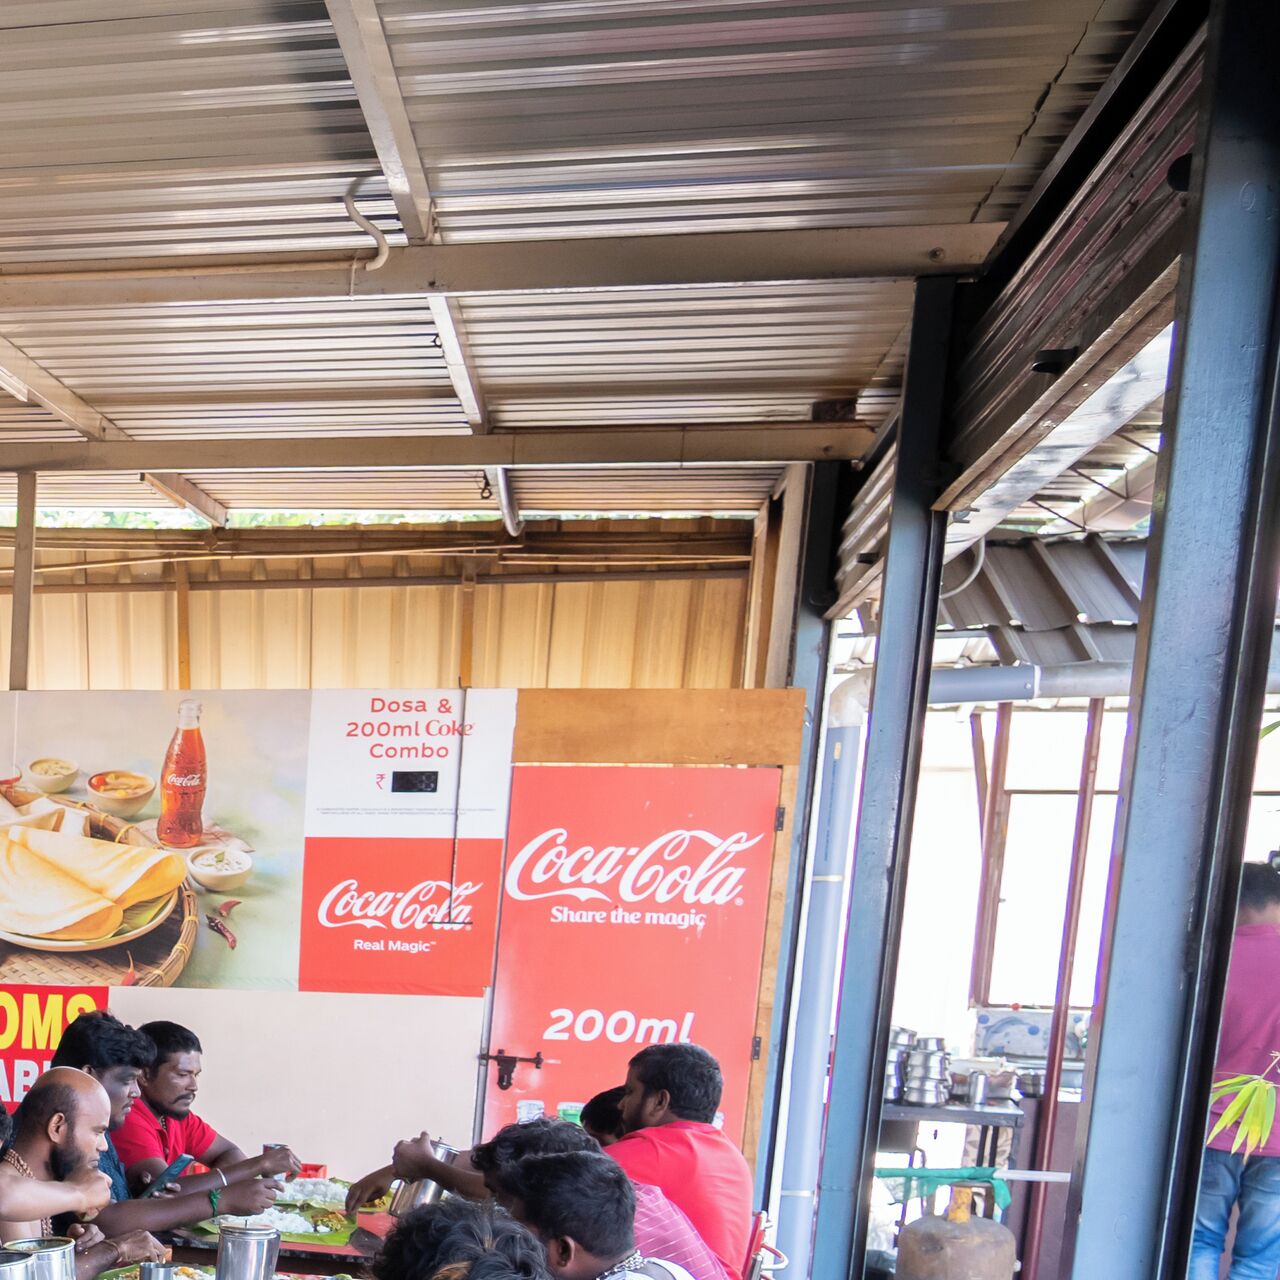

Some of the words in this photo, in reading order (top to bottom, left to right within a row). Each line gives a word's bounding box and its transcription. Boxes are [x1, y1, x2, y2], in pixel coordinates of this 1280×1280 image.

[370, 697, 427, 713] Dosa
[437, 698, 453, 714] &
[346, 720, 420, 737] 200ml
[425, 719, 473, 736] Coke
[369, 743, 449, 758] Combo
[505, 827, 765, 906] Coca-Cola
[317, 879, 484, 931] Coca-Cola
[550, 905, 607, 924] Share
[610, 906, 641, 925] the
[644, 908, 707, 930] magic
[353, 939, 385, 951] Real
[542, 1007, 696, 1045] 200ml
